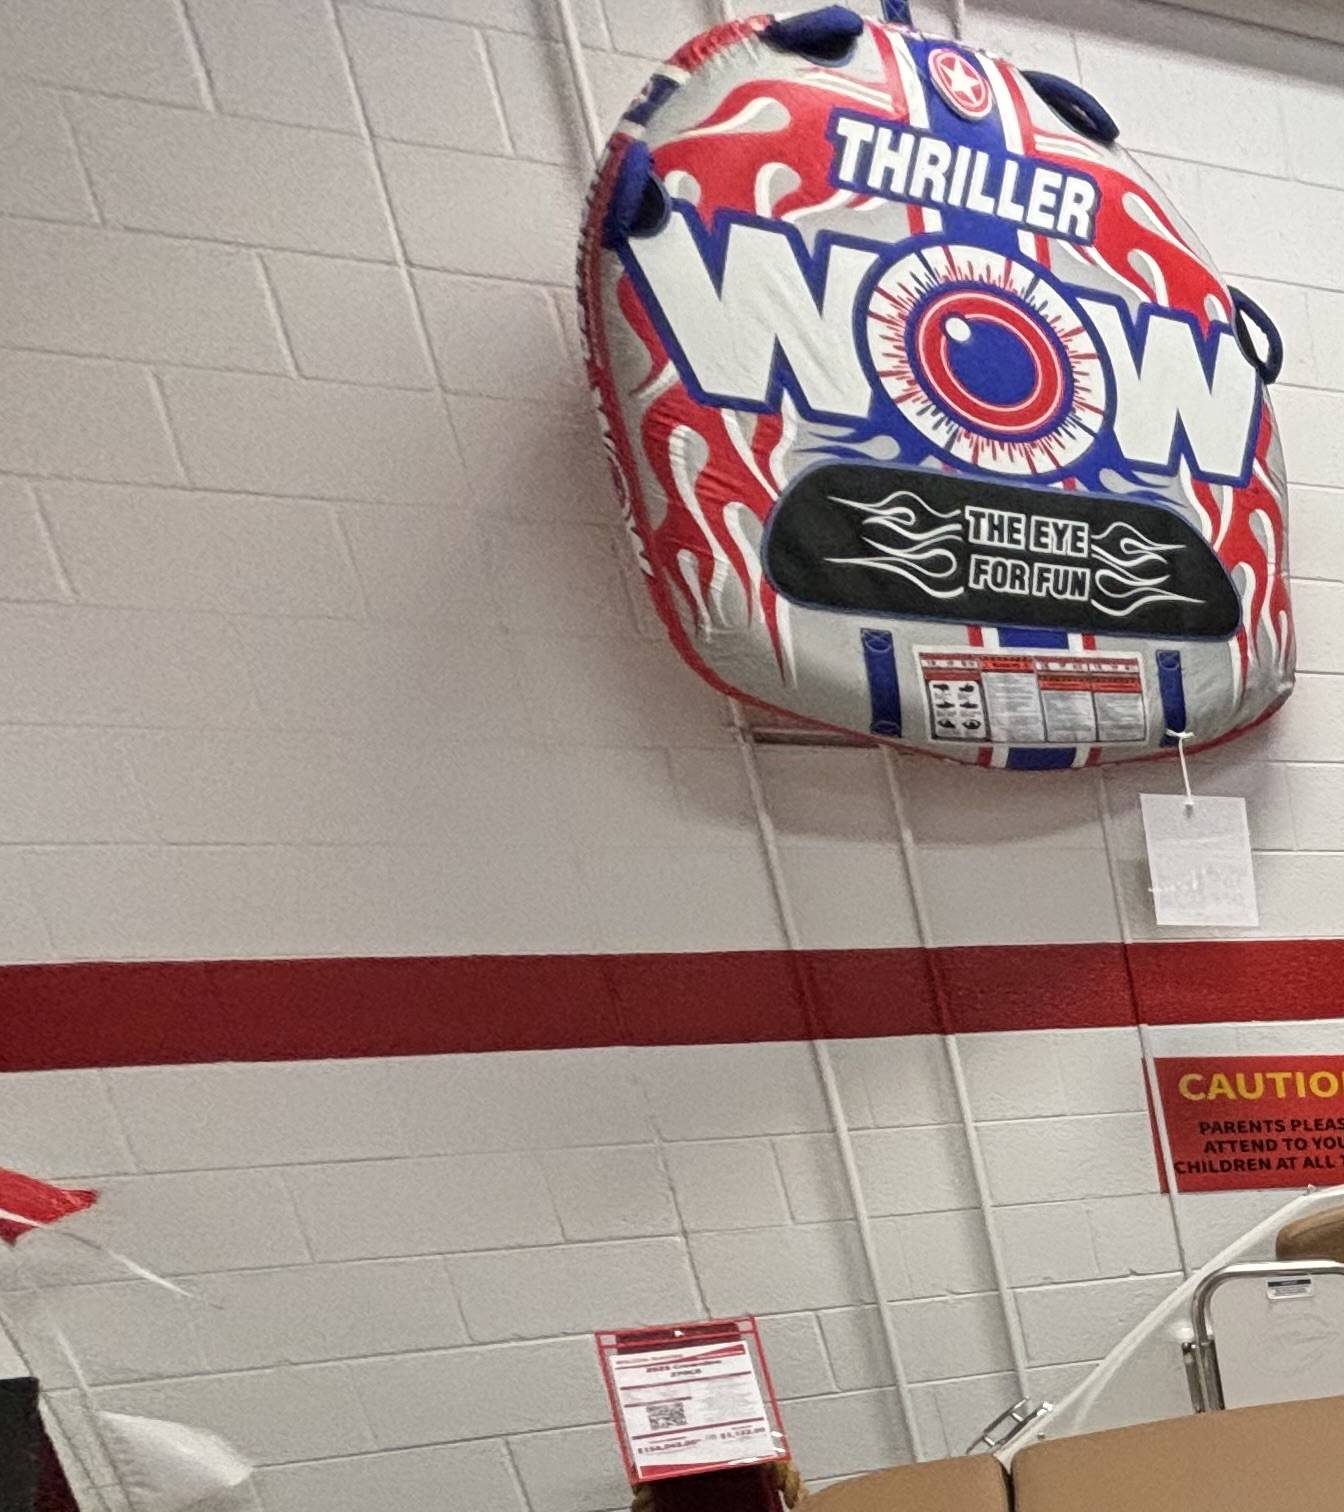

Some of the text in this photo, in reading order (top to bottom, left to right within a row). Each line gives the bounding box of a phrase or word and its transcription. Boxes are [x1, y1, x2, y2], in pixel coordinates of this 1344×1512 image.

[836, 117, 1100, 238] THRILLER
[626, 209, 1263, 482] WOW
[965, 505, 1089, 558] THE EYE
[968, 554, 1091, 601] FOR FUN
[1200, 1119, 1286, 1136] PARENTS
[1203, 1138, 1278, 1154] ATTEND
[1282, 1137, 1307, 1151] TO
[1174, 1158, 1271, 1175] CHILDREN
[1276, 1156, 1297, 1170] AT
[1303, 1155, 1335, 1169] ALL
